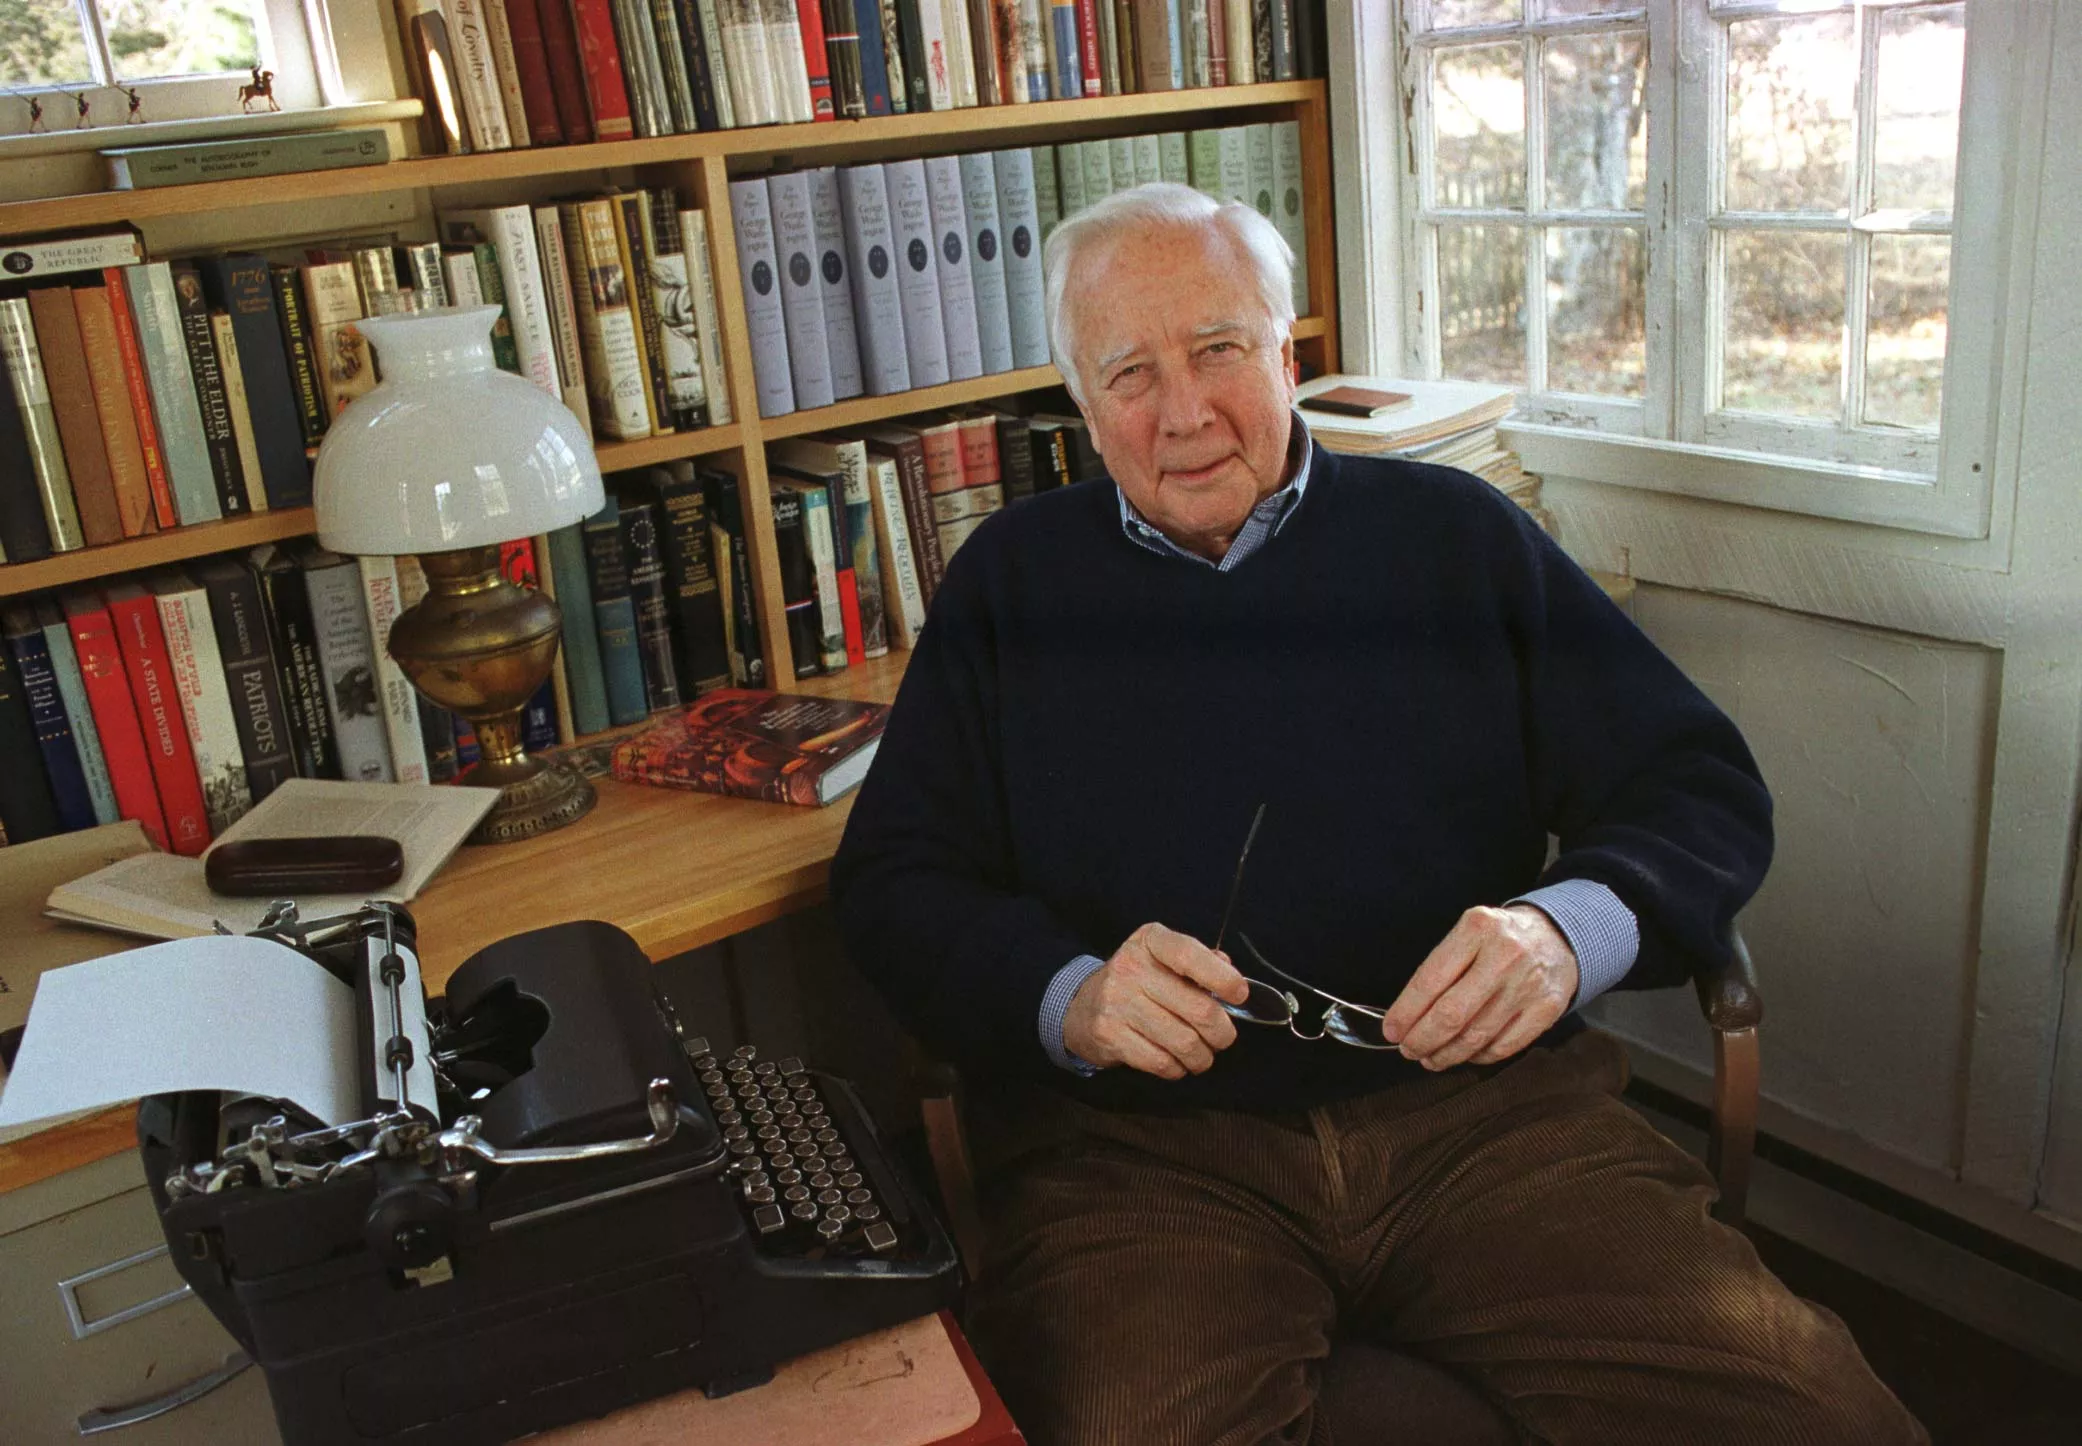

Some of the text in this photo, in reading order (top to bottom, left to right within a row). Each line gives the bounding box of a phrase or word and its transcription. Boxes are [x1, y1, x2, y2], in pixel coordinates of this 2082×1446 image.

[460, 21, 490, 82] Loyalty
[41, 245, 104, 259] THE GREAT
[48, 256, 100, 269] REPUBLIC
[231, 268, 267, 289] 1776
[507, 228, 542, 342] FIRST SALUTE
[550, 254, 568, 318] REVOLUTIONS
[191, 312, 213, 350] PITT
[280, 285, 319, 418] PORTRAIT OF PATRIOTISM
[183, 314, 218, 440] THE GREAT COMMONER
[199, 352, 220, 386] THE
[206, 388, 232, 440] ELDER
[910, 453, 921, 463] A
[911, 464, 936, 536] Revolutionary
[924, 537, 942, 572] People
[380, 576, 397, 614] FACES
[140, 657, 174, 757] A STATE DIVIDED
[241, 669, 277, 755] PATRIOTS
[289, 642, 310, 696] AMERICAN
[301, 697, 325, 766] REVOLUTION
[306, 663, 328, 727] RADICALISM
